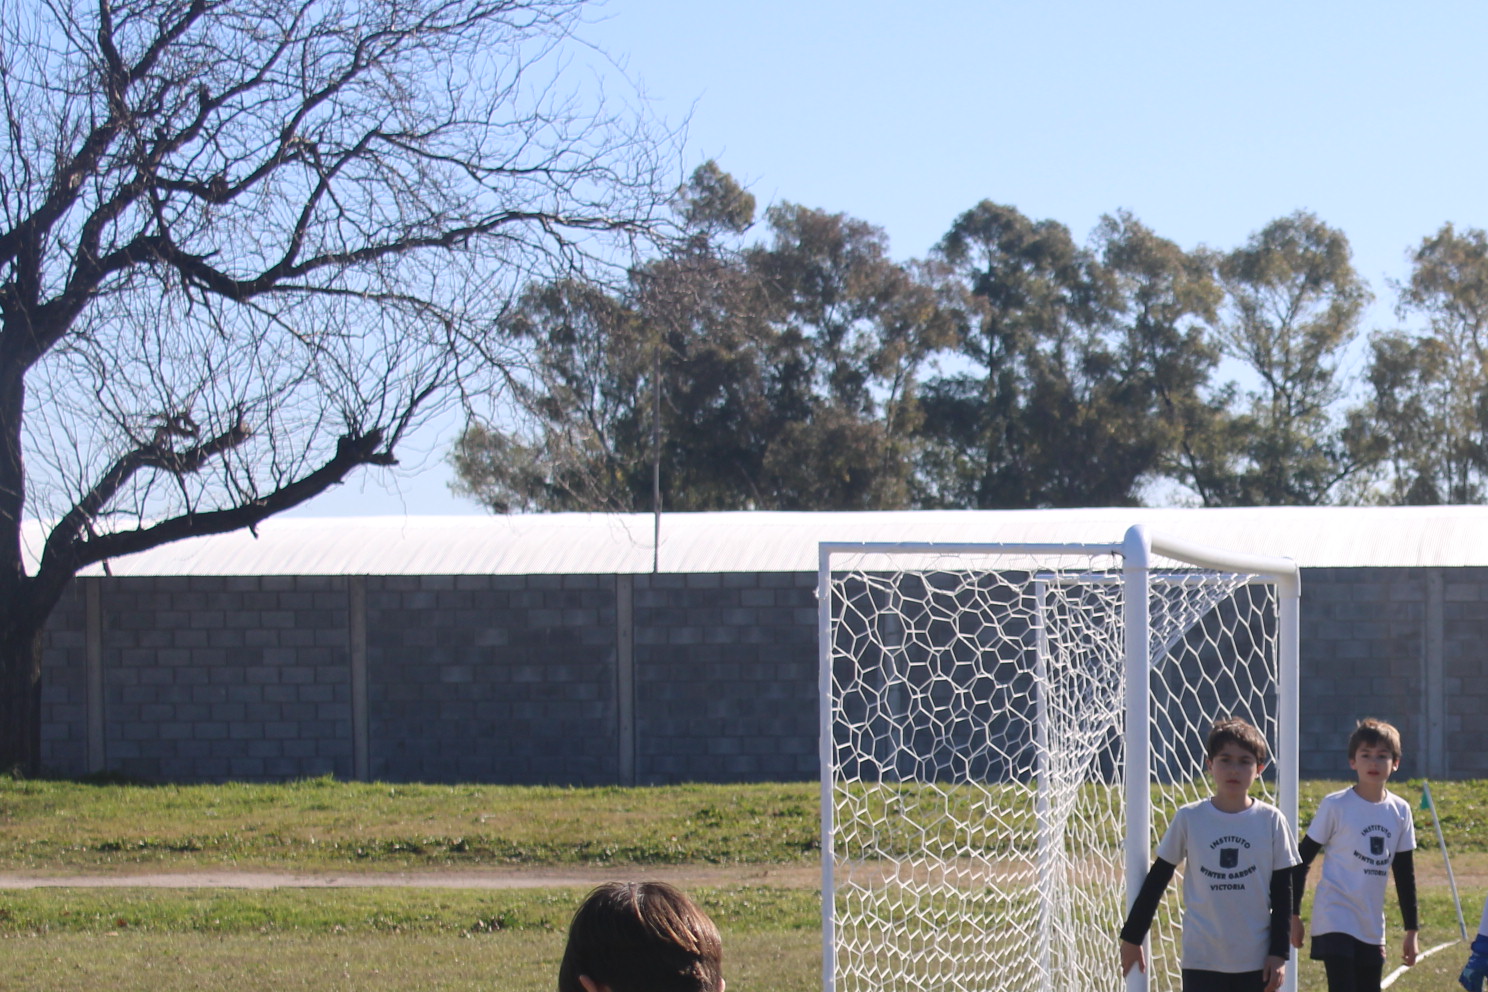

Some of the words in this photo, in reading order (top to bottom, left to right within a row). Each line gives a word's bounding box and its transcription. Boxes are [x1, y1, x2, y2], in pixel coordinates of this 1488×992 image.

[1361, 824, 1391, 838] INSTITUTO
[1209, 835, 1251, 849] INSTITUTO
[1200, 865, 1227, 880] WINTER
[1228, 864, 1257, 879] GARDEN
[1210, 883, 1246, 891] VICTORIA
